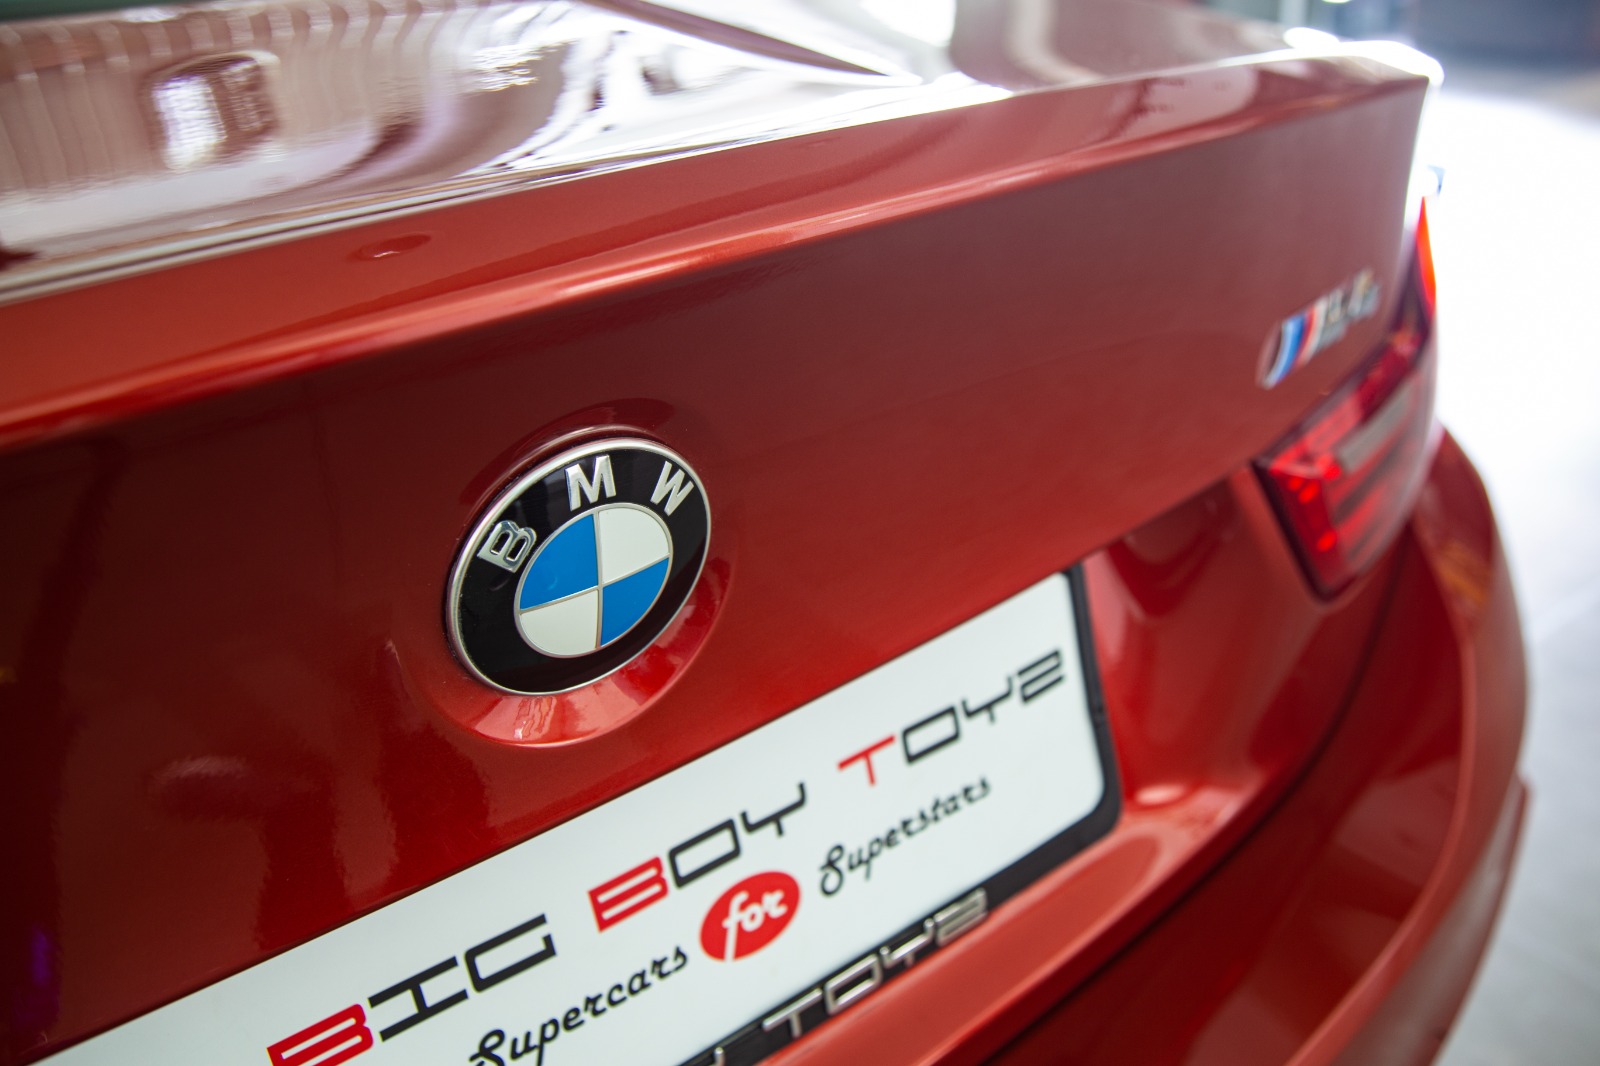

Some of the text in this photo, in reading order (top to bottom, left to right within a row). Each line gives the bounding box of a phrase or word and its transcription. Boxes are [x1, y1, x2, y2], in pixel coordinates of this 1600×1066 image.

[477, 454, 694, 573] BMW
[266, 913, 557, 1066] BIG
[588, 781, 806, 933] BOY
[468, 777, 991, 1066] Supercars for Superstars
